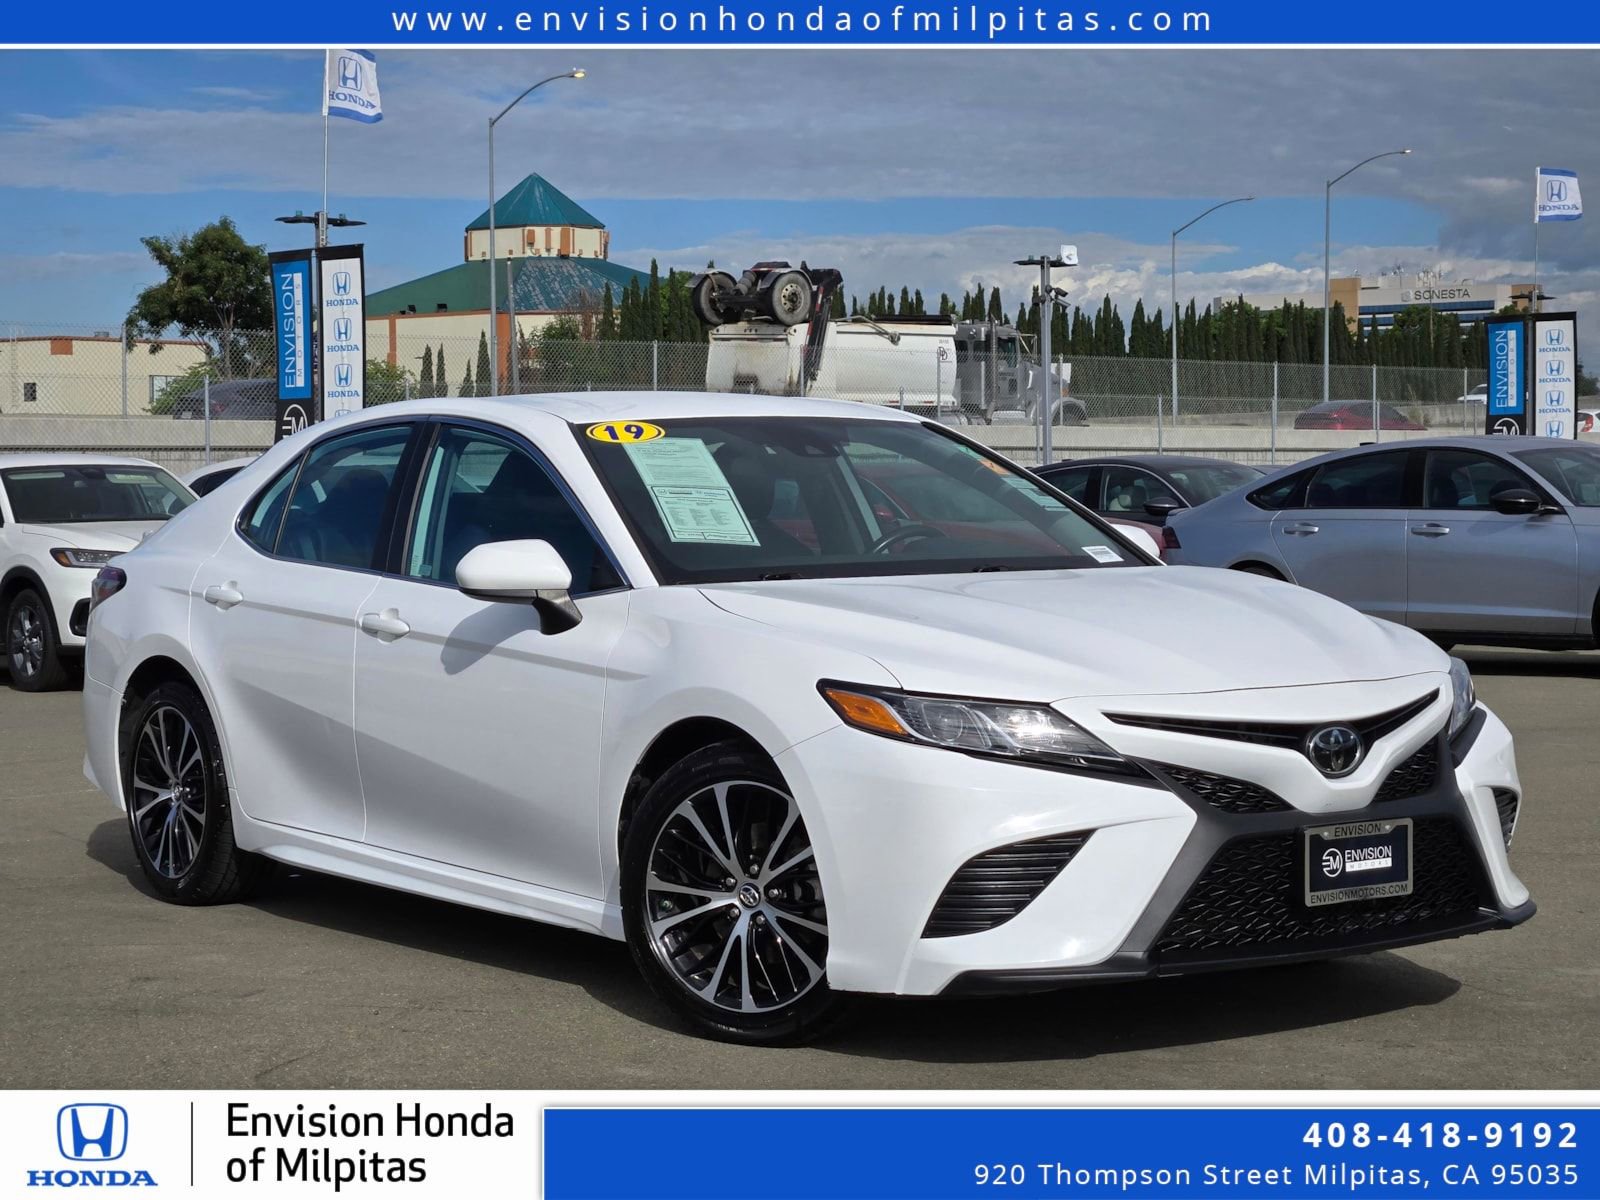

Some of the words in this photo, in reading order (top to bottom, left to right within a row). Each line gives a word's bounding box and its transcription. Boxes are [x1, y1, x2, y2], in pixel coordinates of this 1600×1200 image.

[328, 90, 377, 110] HONDA
[1538, 204, 1580, 212] HONDA
[326, 298, 359, 307] HONDA
[1414, 289, 1471, 300] SONESTA
[281, 272, 296, 389] ENVISION
[295, 283, 303, 377] MOTORS
[327, 344, 360, 353] HONDA
[1495, 330, 1508, 408] ENVISION
[327, 390, 360, 398] HONDA
[603, 425, 645, 441] 19
[1334, 824, 1381, 837] ENVISION
[1345, 845, 1392, 862] ENVISION
[1310, 884, 1408, 904] ENVISIONMOTORS.COM
